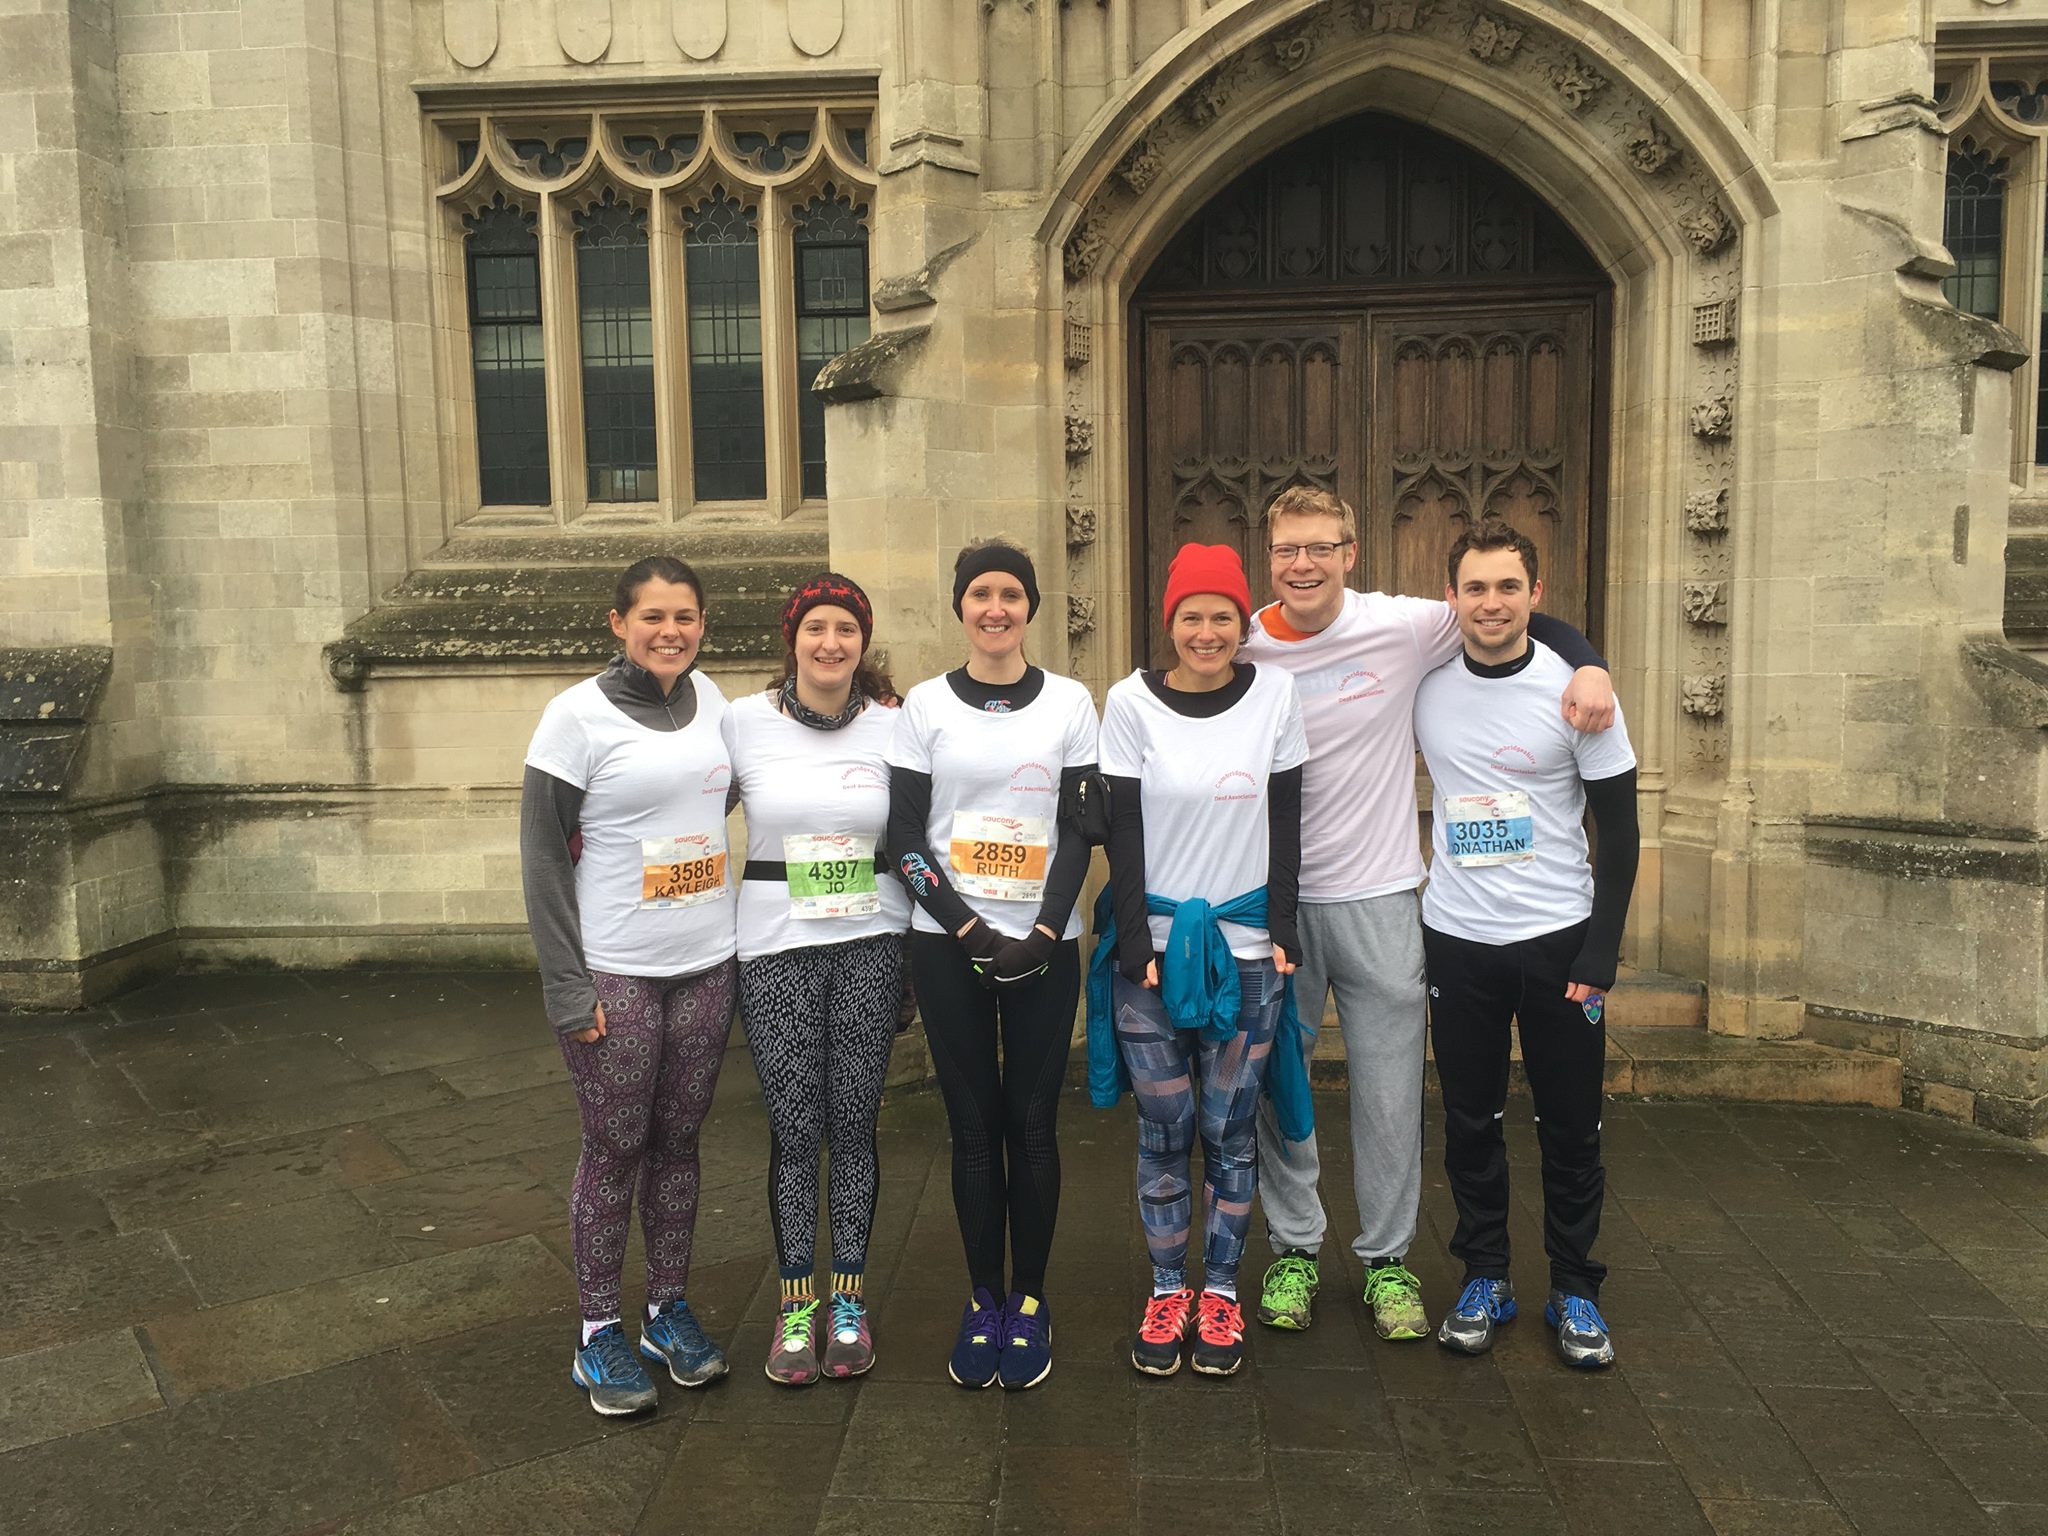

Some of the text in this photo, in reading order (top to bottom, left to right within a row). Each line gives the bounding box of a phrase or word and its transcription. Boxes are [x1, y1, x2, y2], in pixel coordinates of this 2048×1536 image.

[1338, 670, 1381, 691] Cambridgeshire
[1338, 689, 1385, 704] Deaf Association
[1492, 745, 1536, 764] Cambridgeshire
[1215, 770, 1256, 789] Cambridgeshire
[1504, 766, 1537, 775] Association
[982, 815, 1015, 825] saucony
[674, 834, 704, 843] saucony
[812, 834, 843, 842] saucony
[1455, 819, 1509, 841] 3035
[972, 841, 1027, 864] 2859
[1452, 838, 1526, 856] ONATHAN
[669, 857, 714, 884] 3586
[808, 860, 859, 881] 4397
[976, 862, 1020, 878] RUTH
[654, 875, 721, 898] KAYLEIGH
[825, 881, 845, 894] JO
[1021, 892, 1037, 900] 2859
